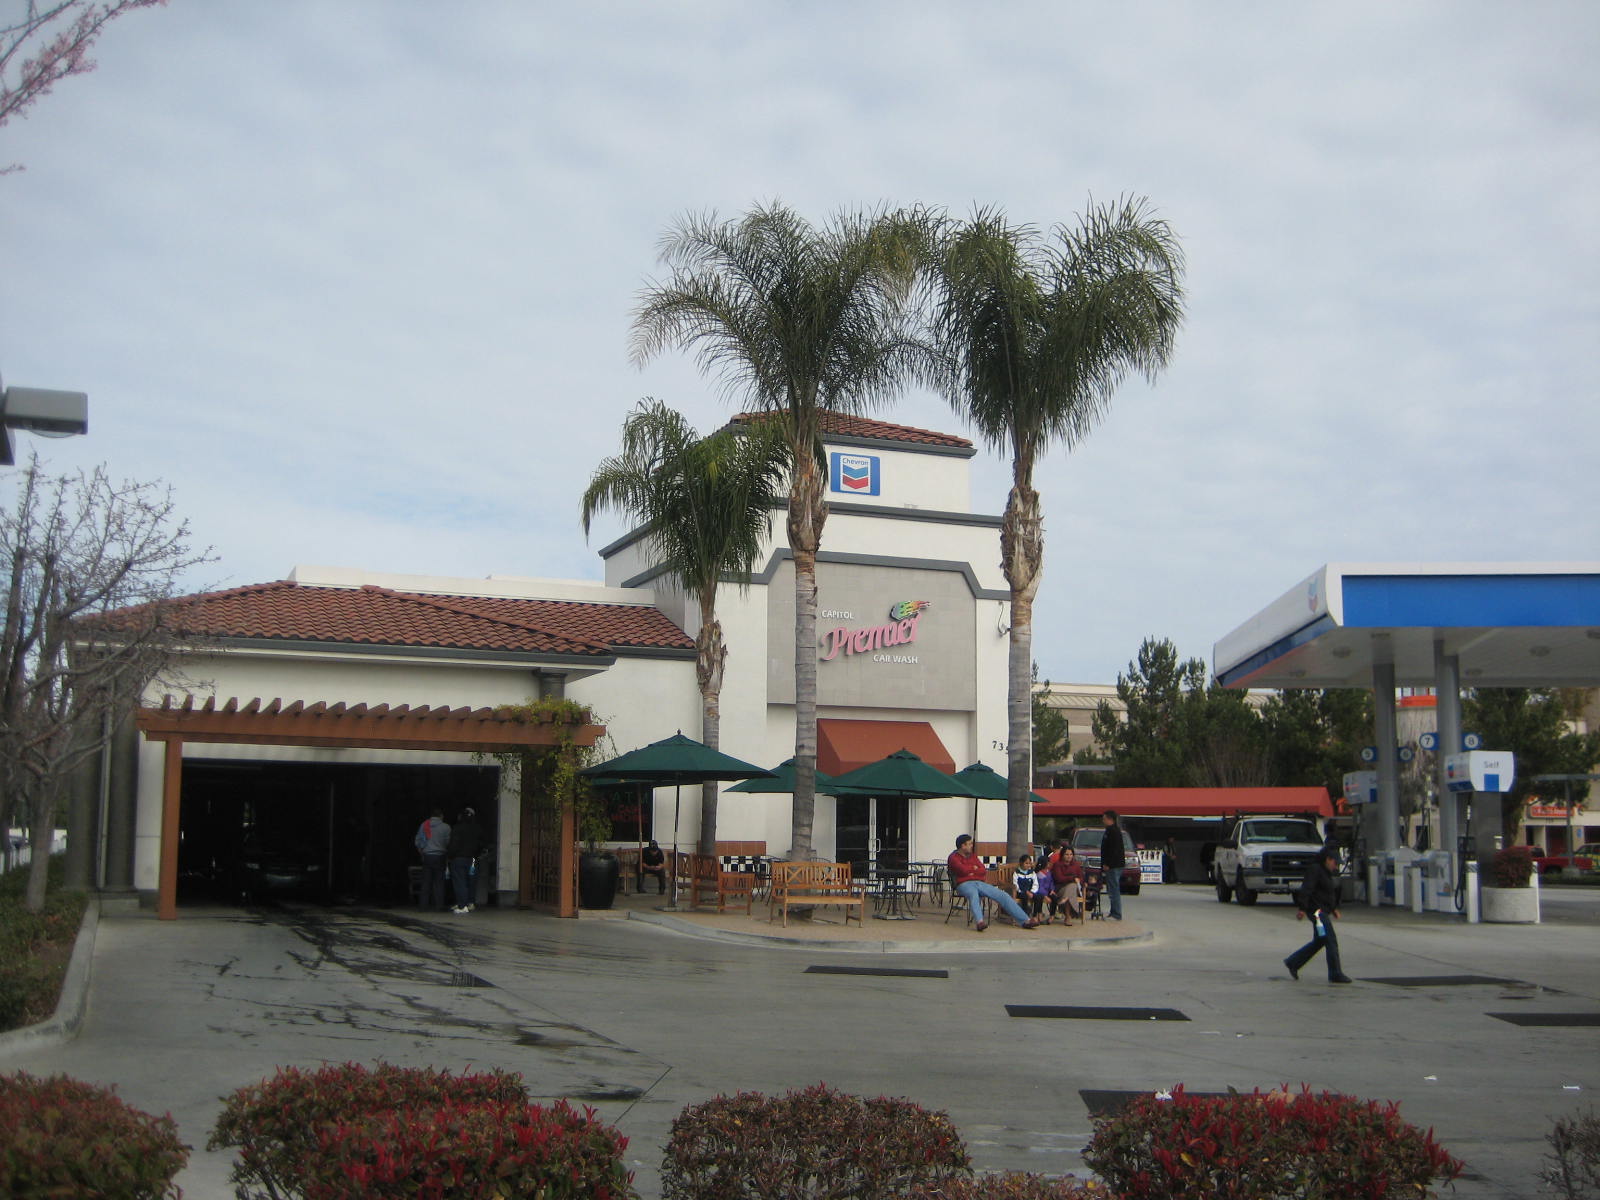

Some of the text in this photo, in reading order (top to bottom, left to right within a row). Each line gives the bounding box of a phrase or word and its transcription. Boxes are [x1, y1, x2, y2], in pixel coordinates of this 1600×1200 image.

[842, 458, 869, 466] Chevron
[821, 610, 854, 619] CAPITOL
[819, 612, 923, 661] Premier
[873, 654, 918, 664] CAR WASH
